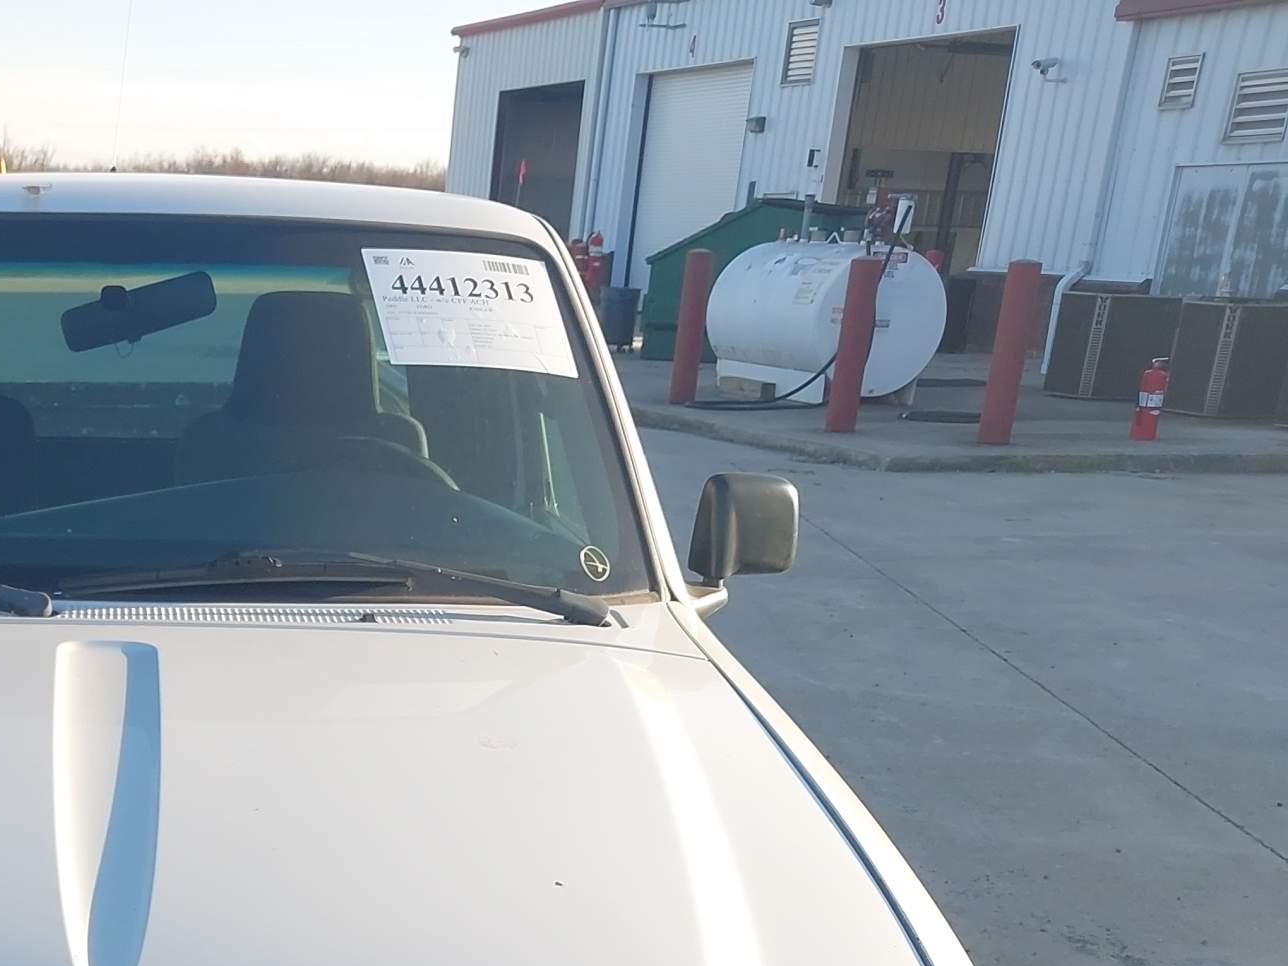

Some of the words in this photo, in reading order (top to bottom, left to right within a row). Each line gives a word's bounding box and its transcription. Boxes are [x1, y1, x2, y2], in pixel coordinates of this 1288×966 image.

[936, 0, 947, 24] 3
[689, 35, 697, 57] 4
[391, 274, 534, 303] 44412313
